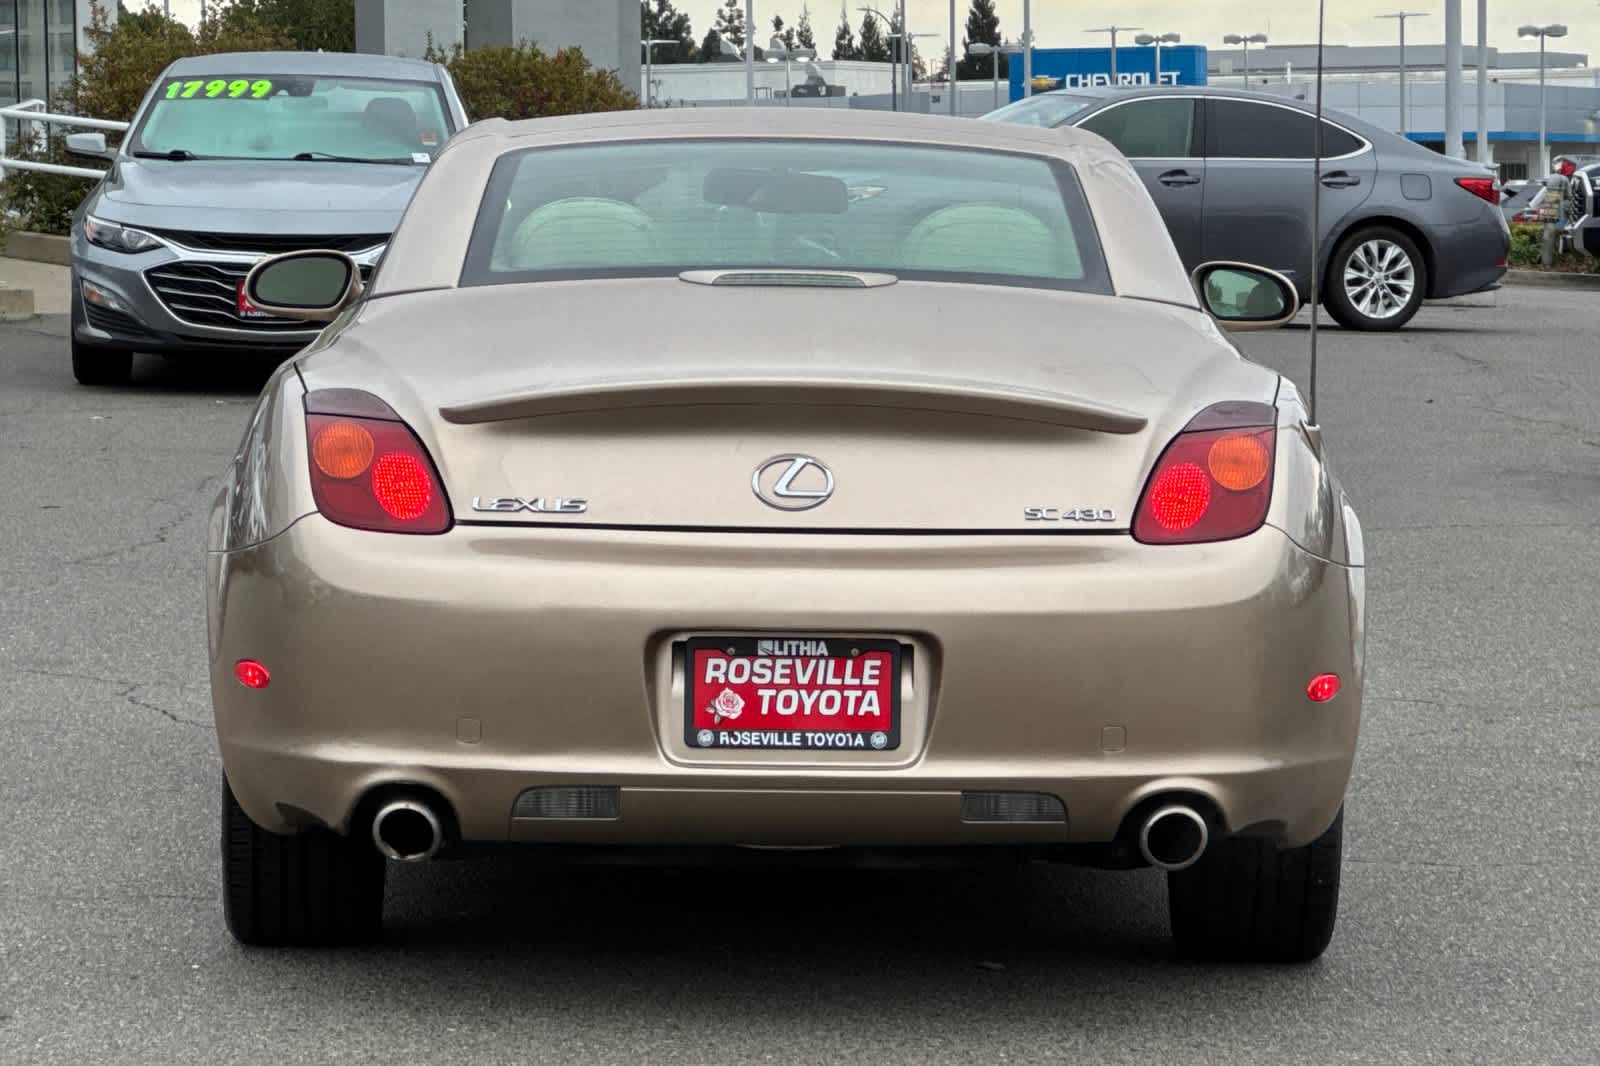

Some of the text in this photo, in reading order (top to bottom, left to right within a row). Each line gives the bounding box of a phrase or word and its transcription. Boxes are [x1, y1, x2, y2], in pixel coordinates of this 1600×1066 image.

[165, 79, 272, 99] 17999
[1065, 71, 1181, 89] CHEVROLET
[471, 496, 588, 514] LEXUS
[1023, 506, 1117, 522] SC 430
[773, 640, 829, 656] LITHIA
[704, 658, 882, 686] ROSEVILLE
[757, 688, 881, 717] TOYOTA
[719, 731, 865, 747] ROSEVILLE TOYOTA
